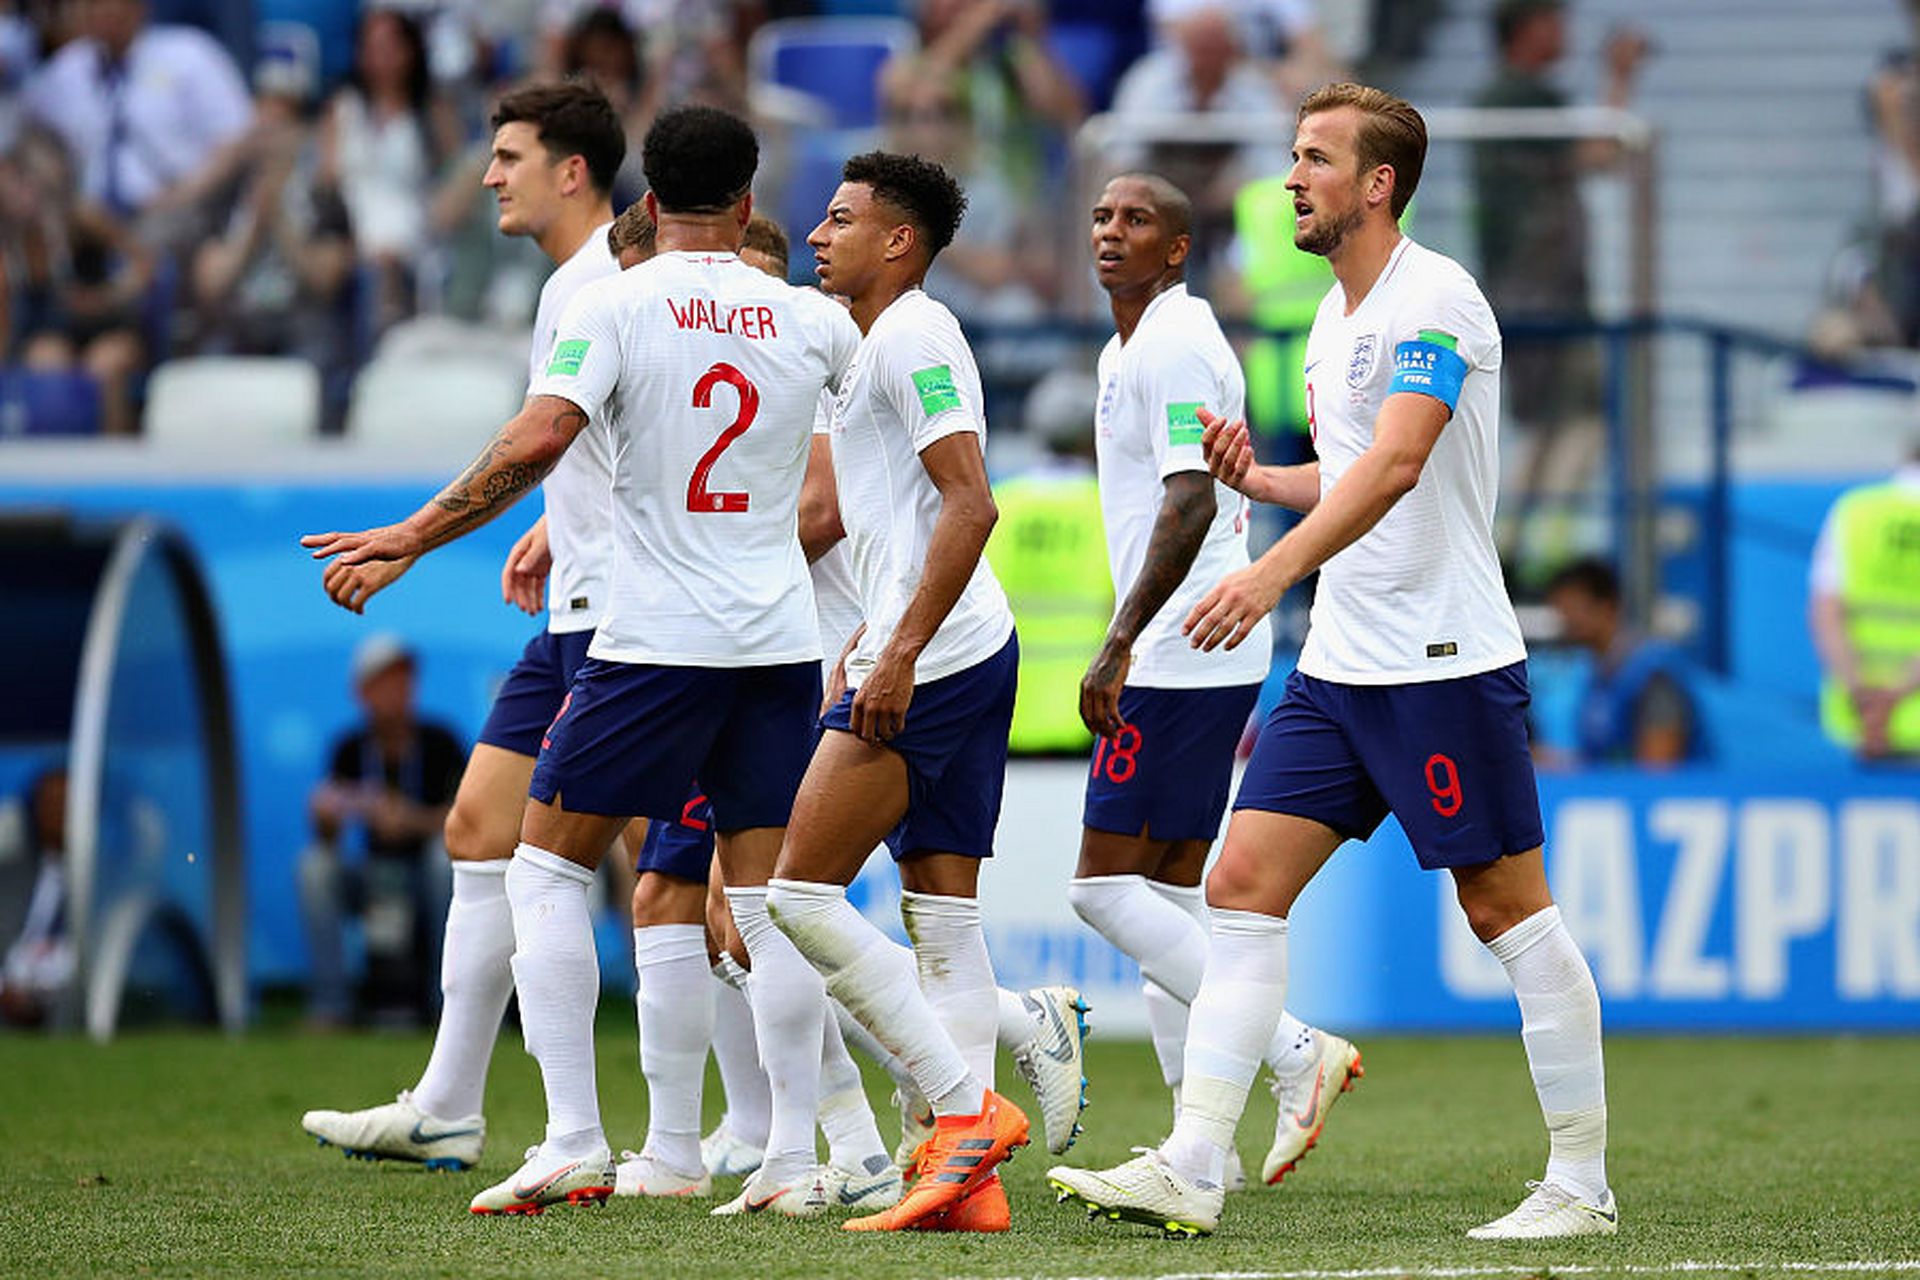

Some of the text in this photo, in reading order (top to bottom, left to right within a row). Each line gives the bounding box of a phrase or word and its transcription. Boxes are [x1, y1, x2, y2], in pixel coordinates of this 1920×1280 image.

[687, 362, 760, 512] 2
[1092, 724, 1143, 783] 18
[1425, 753, 1463, 817] 9
